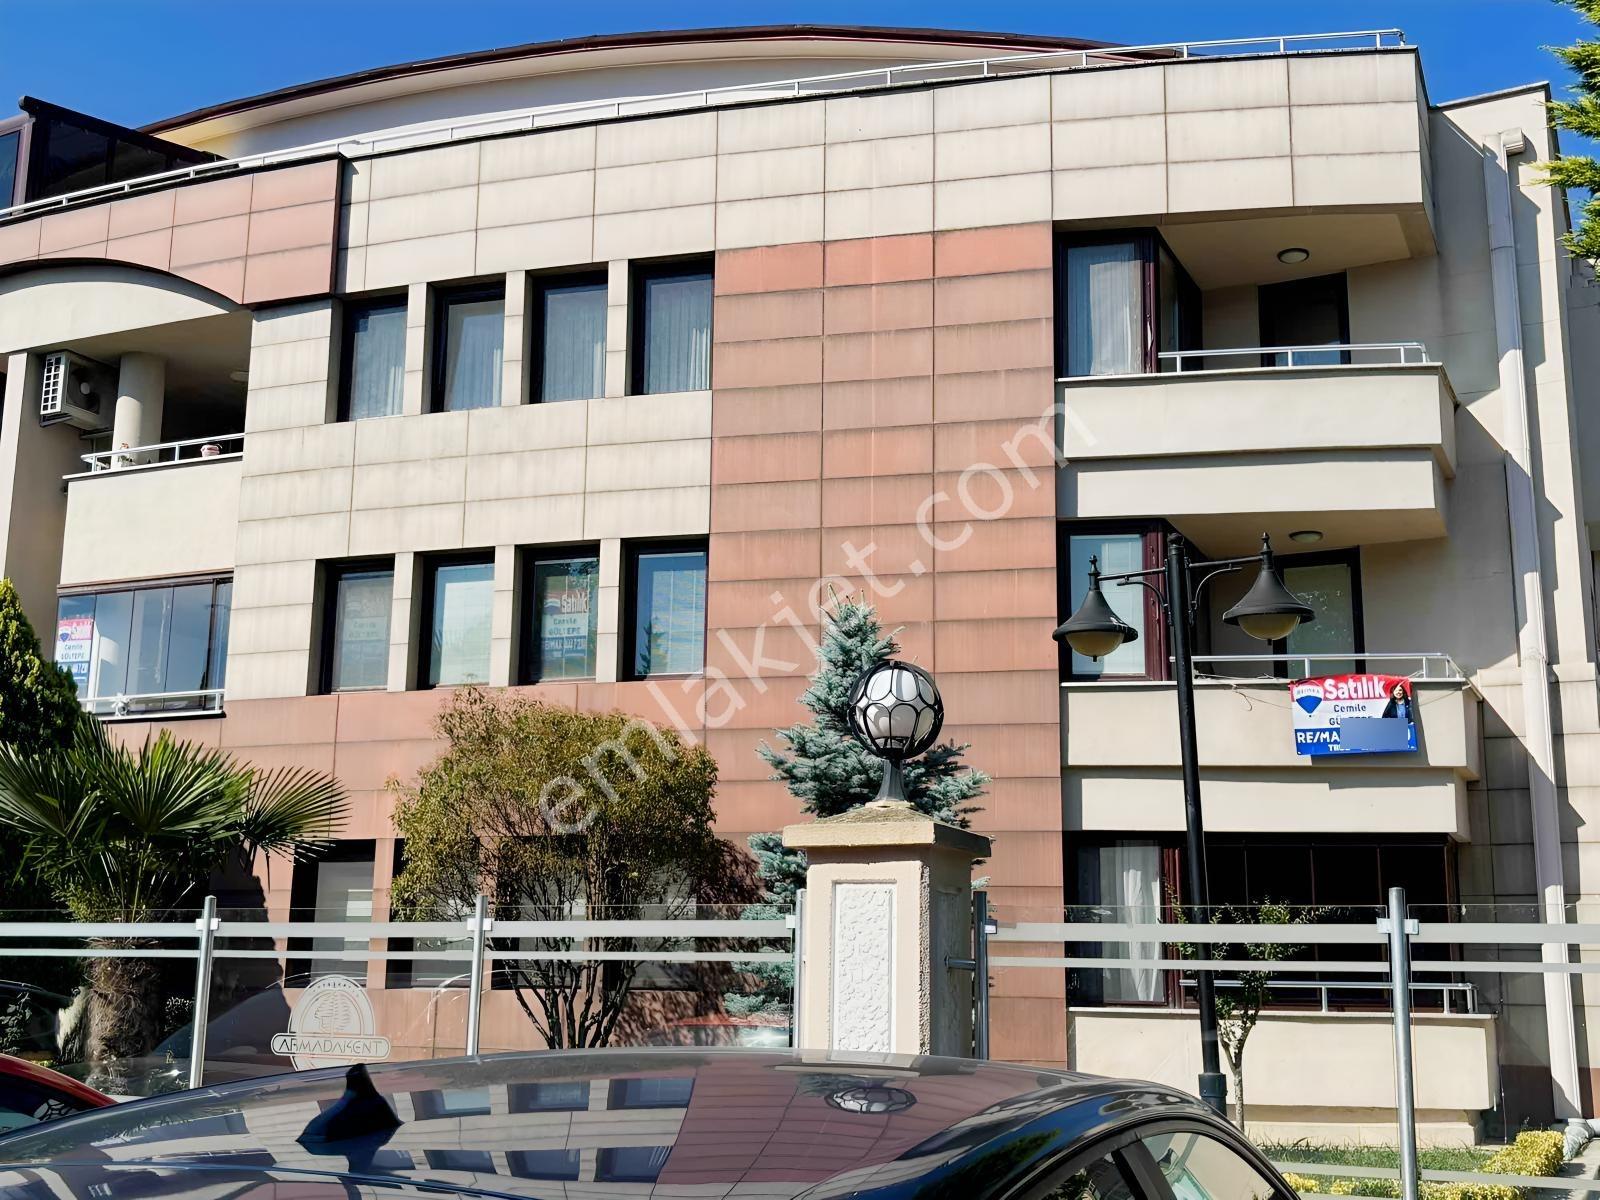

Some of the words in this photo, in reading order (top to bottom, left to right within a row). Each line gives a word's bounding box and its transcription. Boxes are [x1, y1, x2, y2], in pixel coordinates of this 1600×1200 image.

[1324, 675, 1387, 700] Satılık
[1333, 703, 1367, 713] Cemile
[278, 1037, 382, 1054] ARMADAKENT
